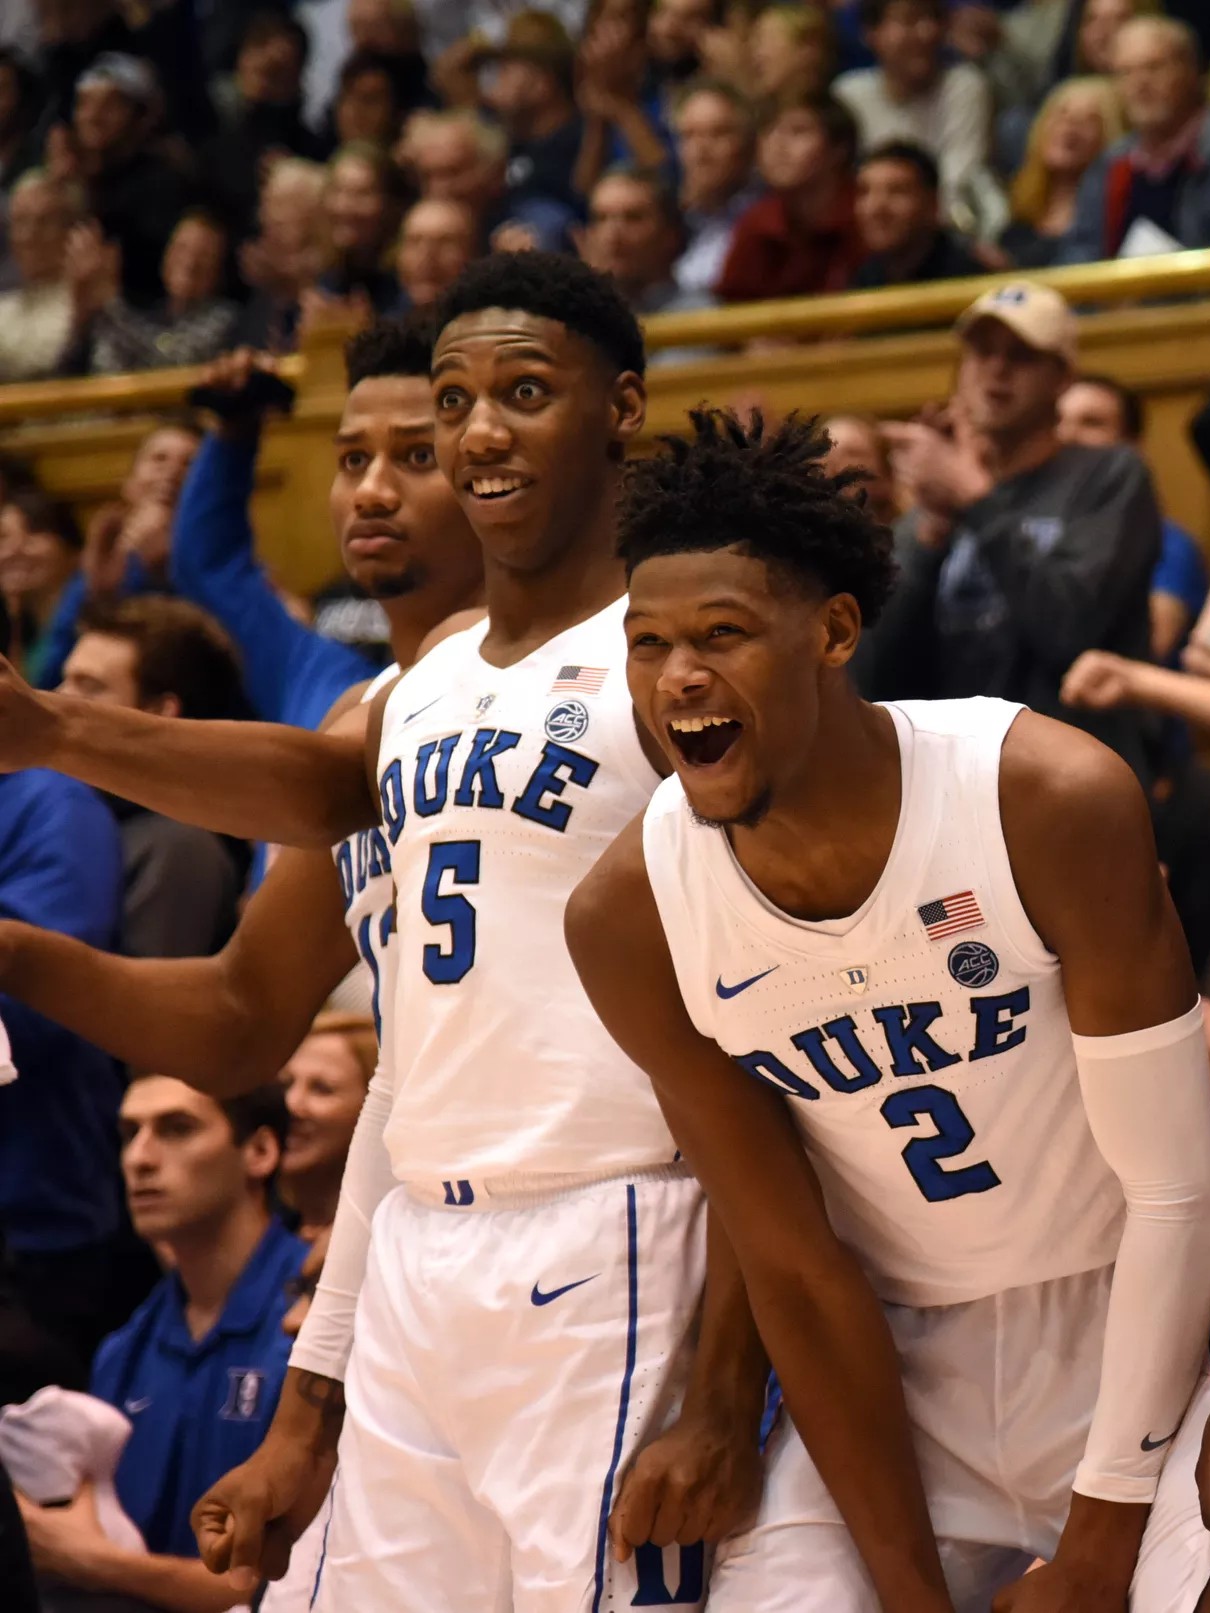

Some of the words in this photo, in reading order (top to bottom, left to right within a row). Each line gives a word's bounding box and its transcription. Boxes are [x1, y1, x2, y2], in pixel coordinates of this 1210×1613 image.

[551, 712, 586, 726] ACC
[379, 728, 600, 846] DUKE
[421, 839, 482, 986] 5
[846, 969, 865, 986] D
[958, 952, 991, 972] ACC
[878, 1083, 1003, 1204] 2
